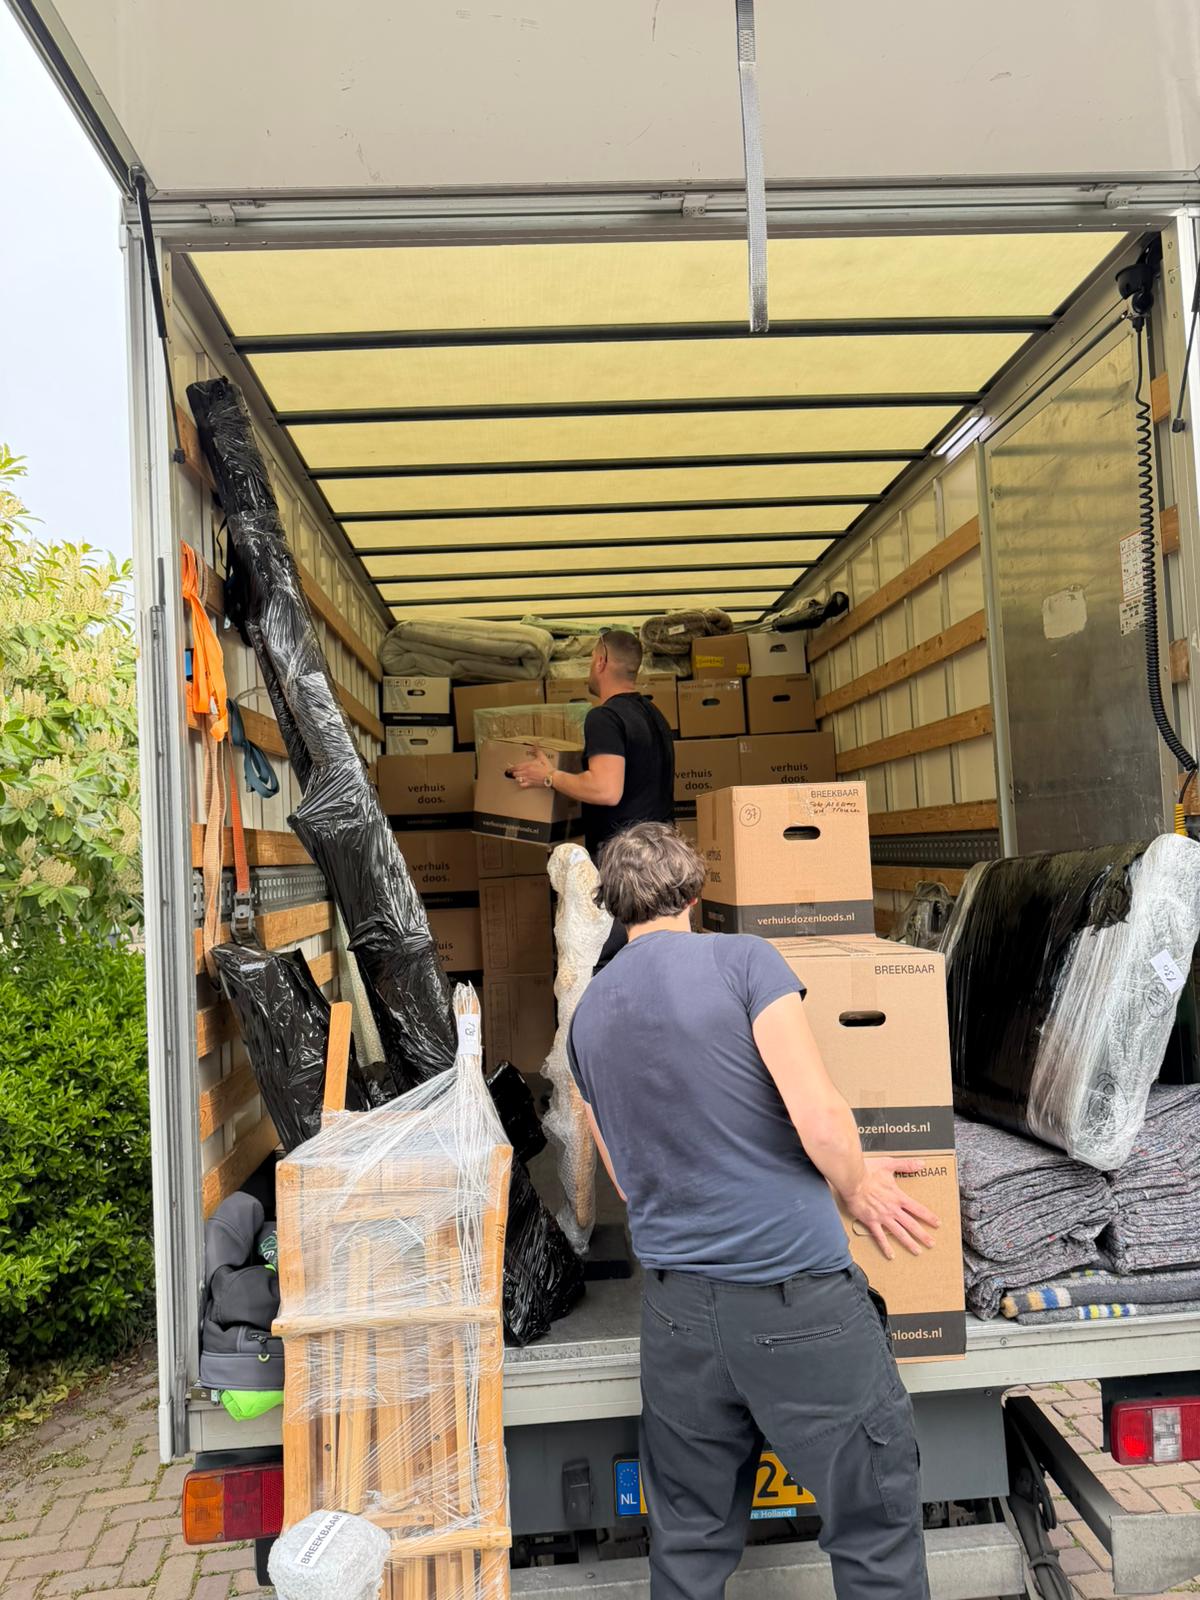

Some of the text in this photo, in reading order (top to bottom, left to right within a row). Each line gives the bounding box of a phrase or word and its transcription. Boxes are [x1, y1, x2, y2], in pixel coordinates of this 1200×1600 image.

[769, 762, 809, 772] verhuis
[674, 769, 713, 779] verhuis
[407, 783, 446, 793] verhuis
[684, 781, 713, 790] doos.
[811, 789, 859, 799] BREEKBAAR
[417, 795, 446, 804] doos.
[411, 861, 450, 871] verhuis
[422, 874, 450, 883] doos.
[757, 912, 855, 925] verhuisdozenloods.nl
[874, 964, 935, 975] BREEKBAAR
[620, 1492, 637, 1505] NL
[761, 1509, 792, 1518] Holland
[300, 1514, 343, 1566] BREEKBAAR
